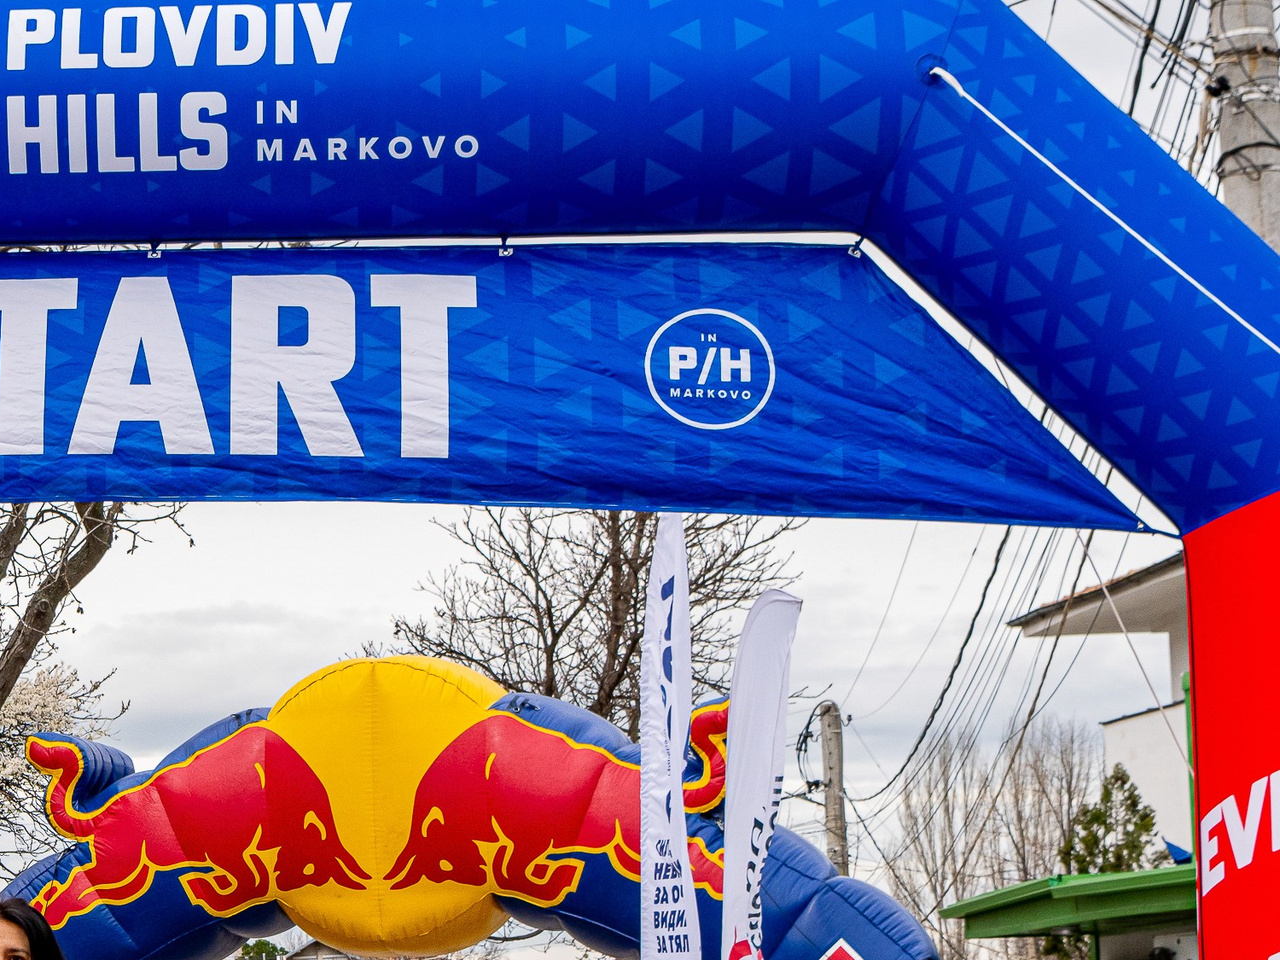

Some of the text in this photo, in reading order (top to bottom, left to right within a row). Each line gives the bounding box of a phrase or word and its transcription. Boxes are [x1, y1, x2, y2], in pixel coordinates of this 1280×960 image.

[6, 2, 352, 70] PLOVDIV
[256, 100, 298, 125] IN
[6, 92, 228, 174] HILLS
[256, 135, 480, 162] MARKOVO
[700, 333, 717, 342] IN
[668, 346, 752, 385] P/H
[670, 388, 751, 400] MARKOVO
[654, 886, 669, 905] ЗА
[656, 935, 668, 953] ЗА
